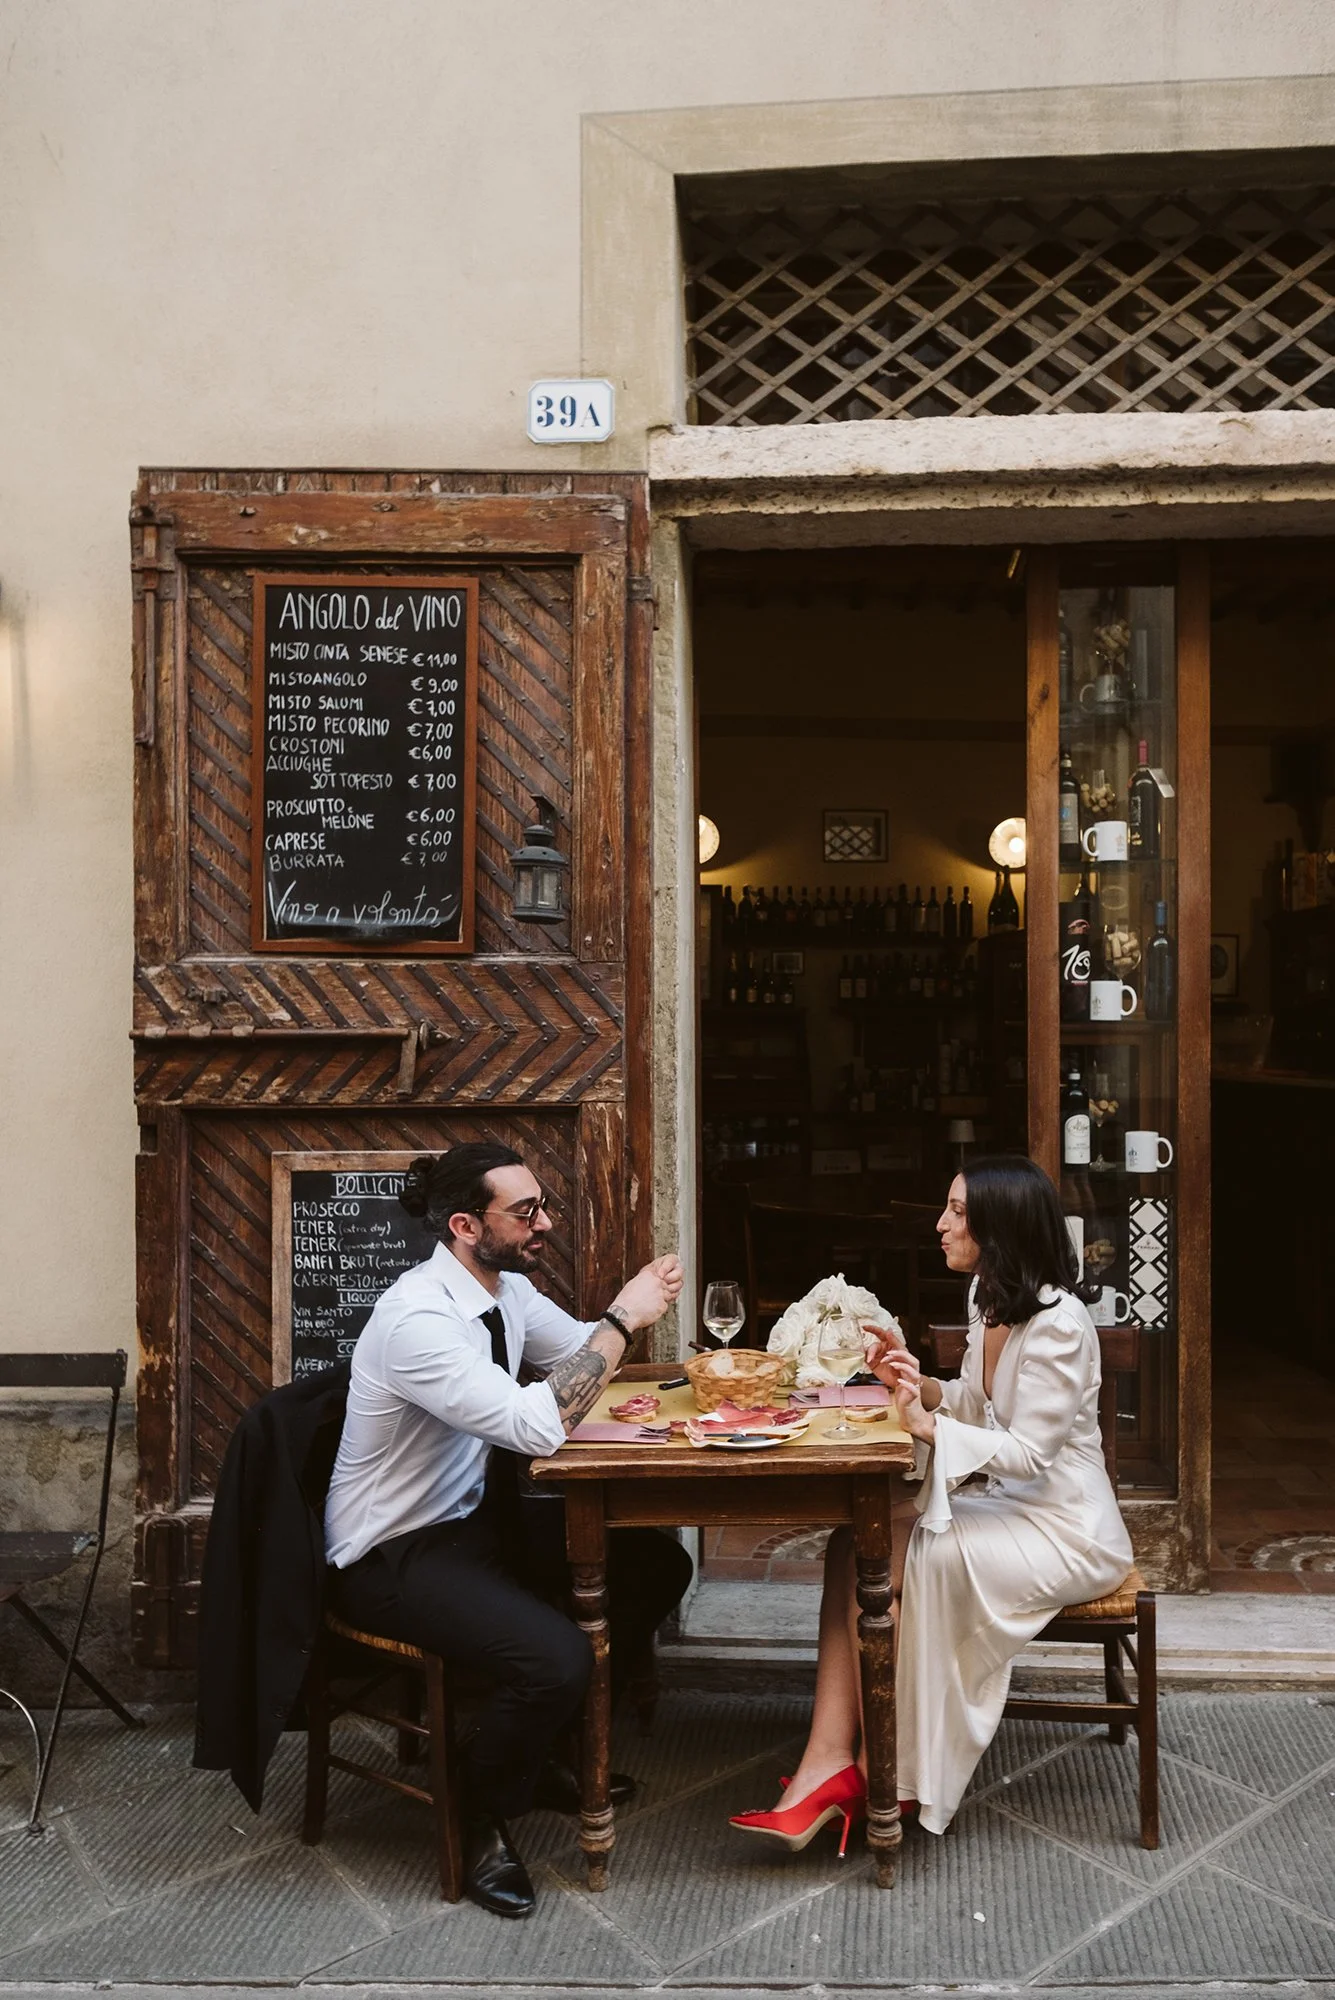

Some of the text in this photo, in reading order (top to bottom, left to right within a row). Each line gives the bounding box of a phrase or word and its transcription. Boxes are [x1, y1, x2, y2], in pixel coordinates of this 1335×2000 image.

[536, 395, 601, 428] 39A
[279, 592, 461, 632] ANGOLO del VINO
[270, 642, 310, 661] MISTO
[314, 643, 350, 661] CINTA
[359, 645, 409, 665] SENESE
[268, 694, 311, 711] MISTO
[318, 697, 364, 712] SALUMI
[268, 714, 317, 732] MISTO
[324, 716, 390, 737] PECORINO
[269, 736, 345, 755] CROSTONI
[266, 756, 332, 773] ACCIUGHE
[267, 798, 345, 818] PROSCIUTTO
[322, 813, 375, 829] MELONE
[265, 832, 326, 851] CAPRESE
[269, 854, 345, 872] BURRATA
[268, 880, 319, 926] Vino
[326, 906, 340, 924] a
[293, 1202, 360, 1218] PROSECCO
[293, 1220, 337, 1235] TENER
[294, 1254, 333, 1270] BANFI
[316, 1306, 353, 1318] SANTO
[295, 1329, 345, 1338] MOSCATO
